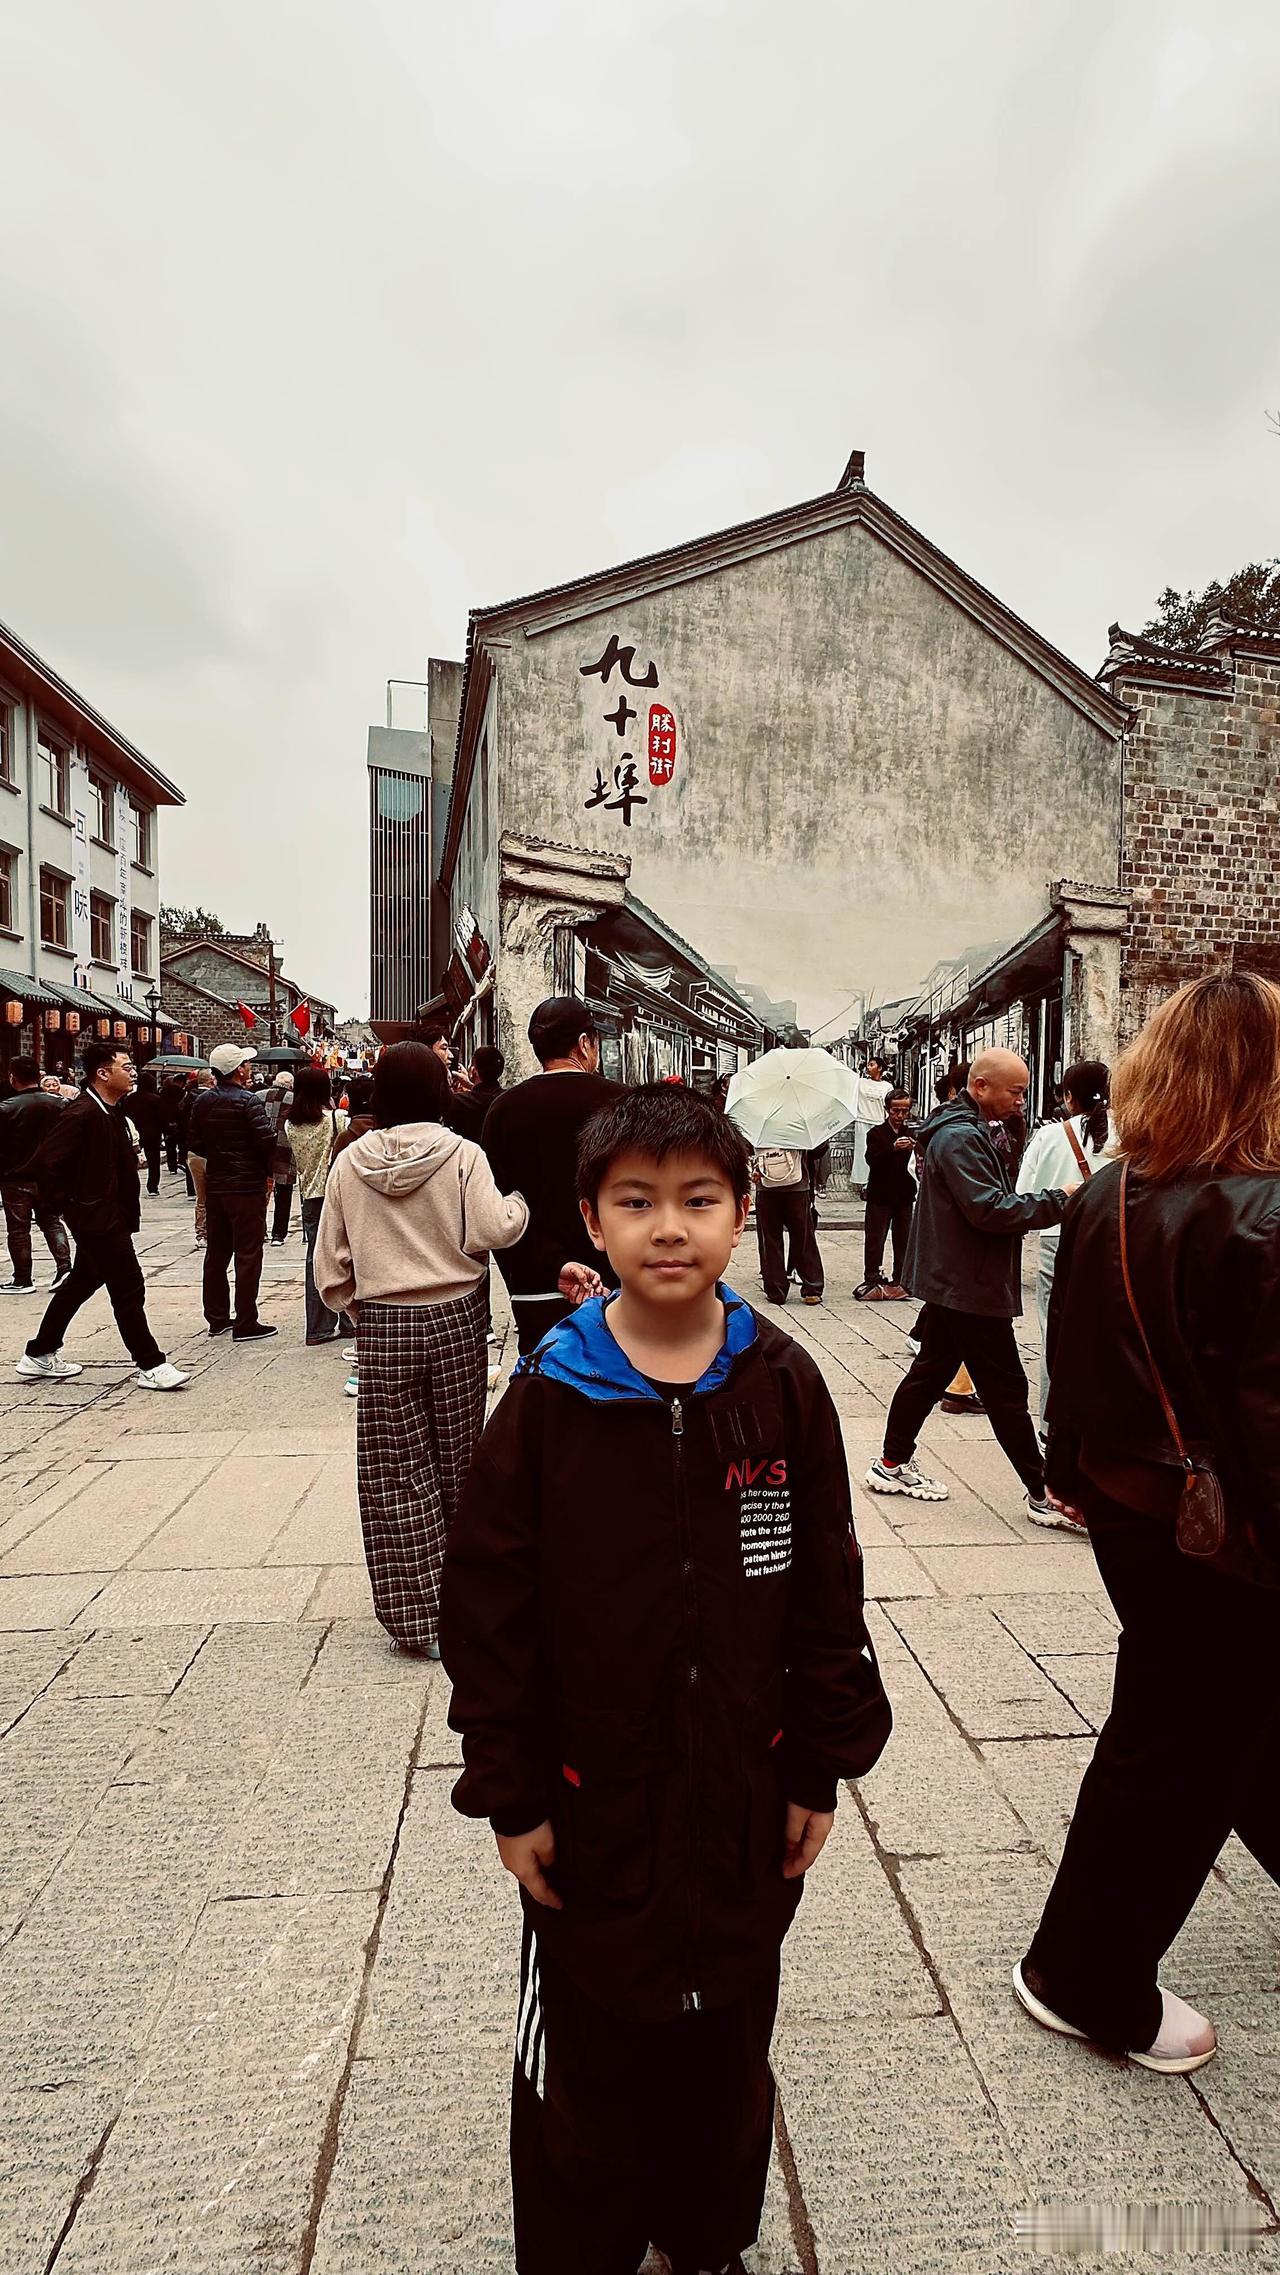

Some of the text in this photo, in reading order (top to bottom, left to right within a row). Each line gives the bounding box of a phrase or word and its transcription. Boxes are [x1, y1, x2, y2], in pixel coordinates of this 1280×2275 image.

[579, 634, 660, 827] 九十埠
[724, 1458, 787, 1489] NVS
[748, 1488, 761, 1498] her
[762, 1489, 780, 1498] own
[771, 1501, 785, 1510] the
[752, 1512, 773, 1522] 2000
[740, 1527, 757, 1538] Note
[757, 1525, 771, 1536] the
[741, 1537, 792, 1551] homogeneous
[745, 1566, 762, 1578] that
